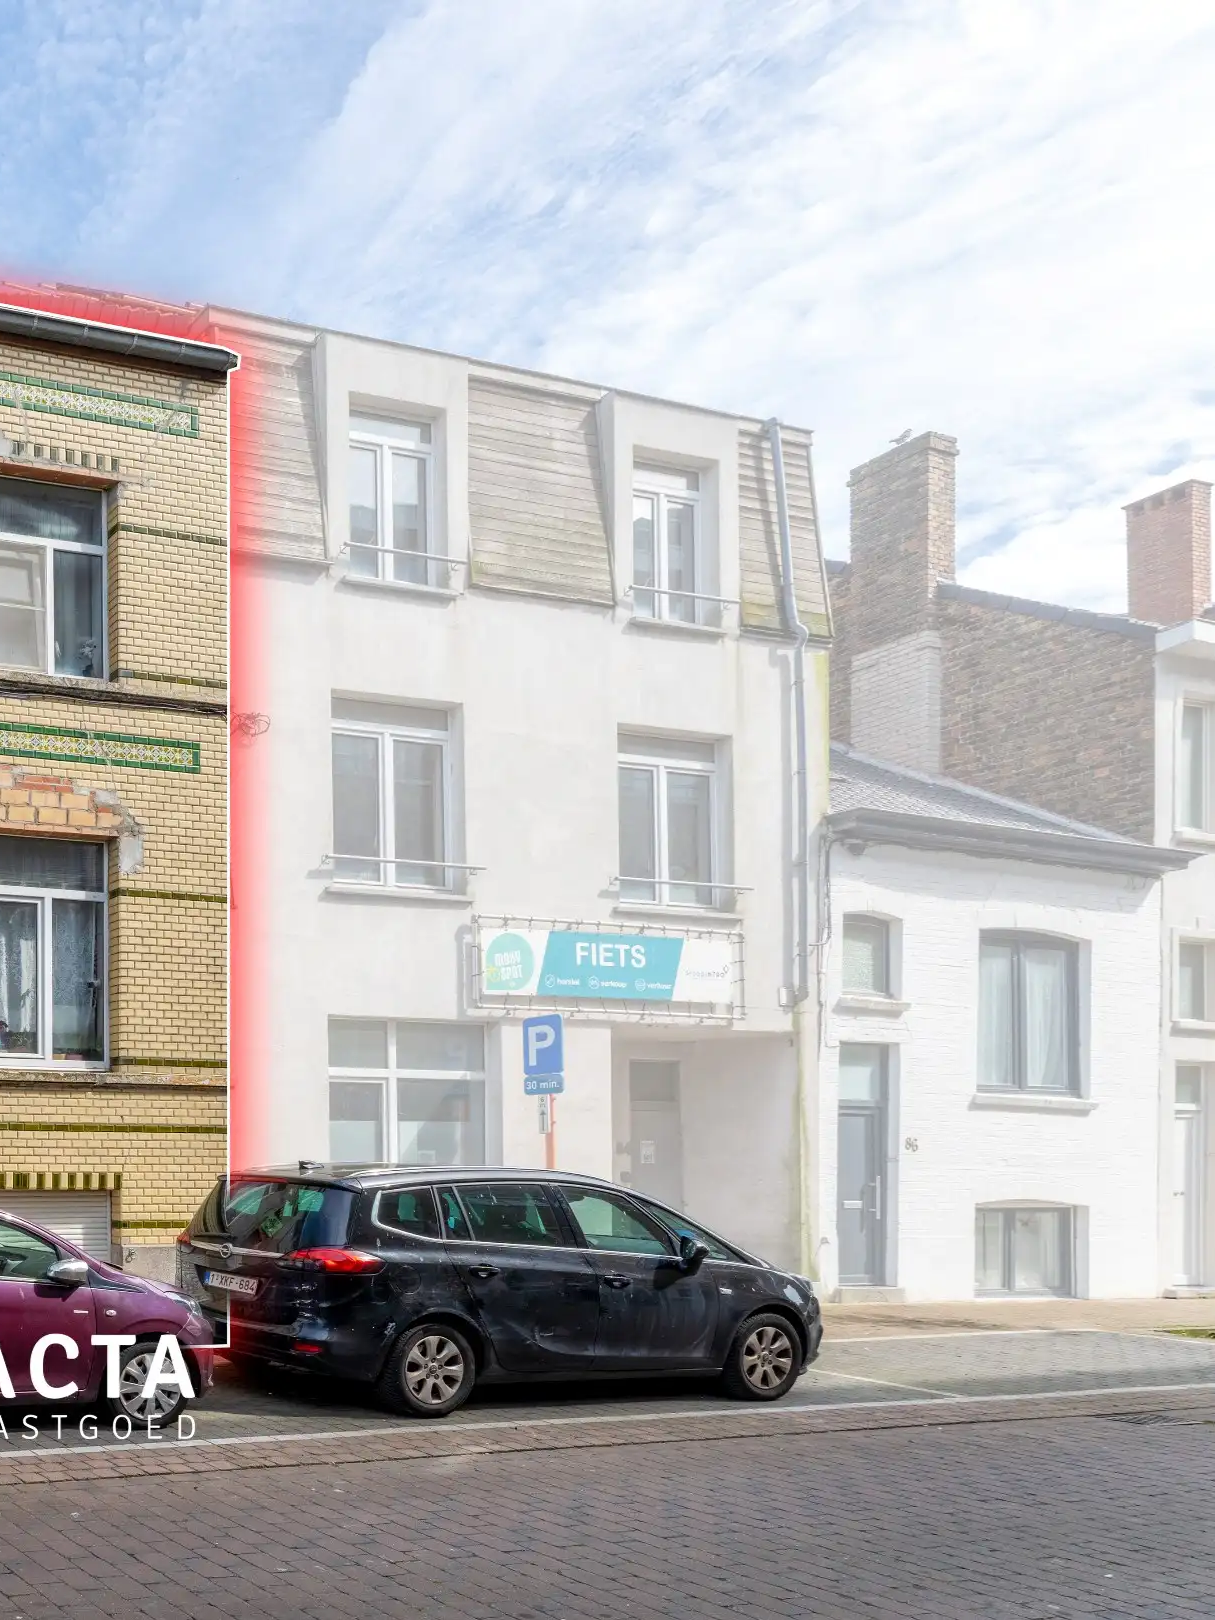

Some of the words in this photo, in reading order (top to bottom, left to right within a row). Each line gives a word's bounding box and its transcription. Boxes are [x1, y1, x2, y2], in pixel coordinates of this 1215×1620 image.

[575, 942, 646, 968] FIETS
[528, 1025, 555, 1066] P
[526, 1081, 537, 1090] 30
[540, 1079, 560, 1089] min.
[905, 1137, 918, 1152] 86
[210, 1272, 255, 1292] 1-XKF-684
